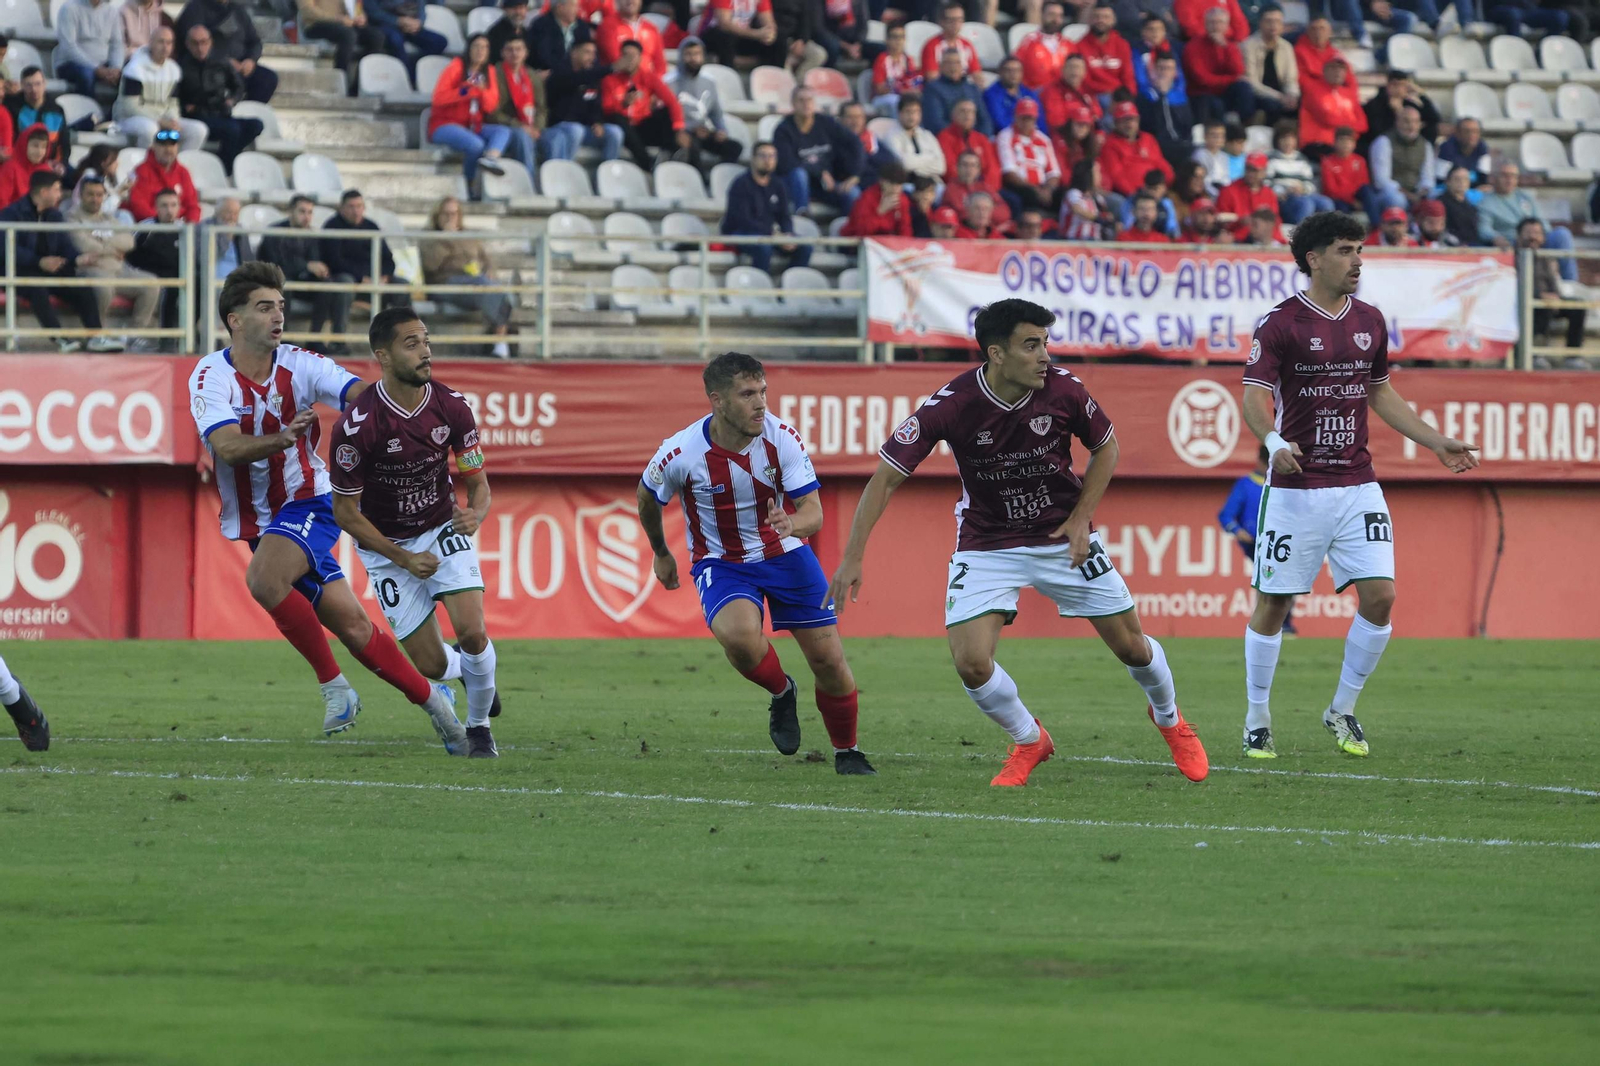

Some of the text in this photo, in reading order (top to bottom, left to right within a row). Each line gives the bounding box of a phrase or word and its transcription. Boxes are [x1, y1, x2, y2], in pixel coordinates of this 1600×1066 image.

[1002, 254, 1310, 299] ORGULLO ALBIRRO
[1157, 315, 1194, 348] EN
[1210, 315, 1238, 348] EL
[1294, 362, 1323, 371] GRUPO
[1325, 361, 1353, 371] SANCHO
[1315, 407, 1338, 416] sabor
[1315, 415, 1321, 424] a
[1315, 425, 1355, 450] laga
[375, 462, 404, 471] GRUPO
[997, 452, 1032, 461] SANCHO
[999, 486, 1024, 497] sabor
[1004, 493, 1054, 520] laga
[1265, 530, 1292, 563] 16
[949, 562, 970, 590] 2
[374, 577, 400, 610] 10
[0, 601, 70, 625] ersario
